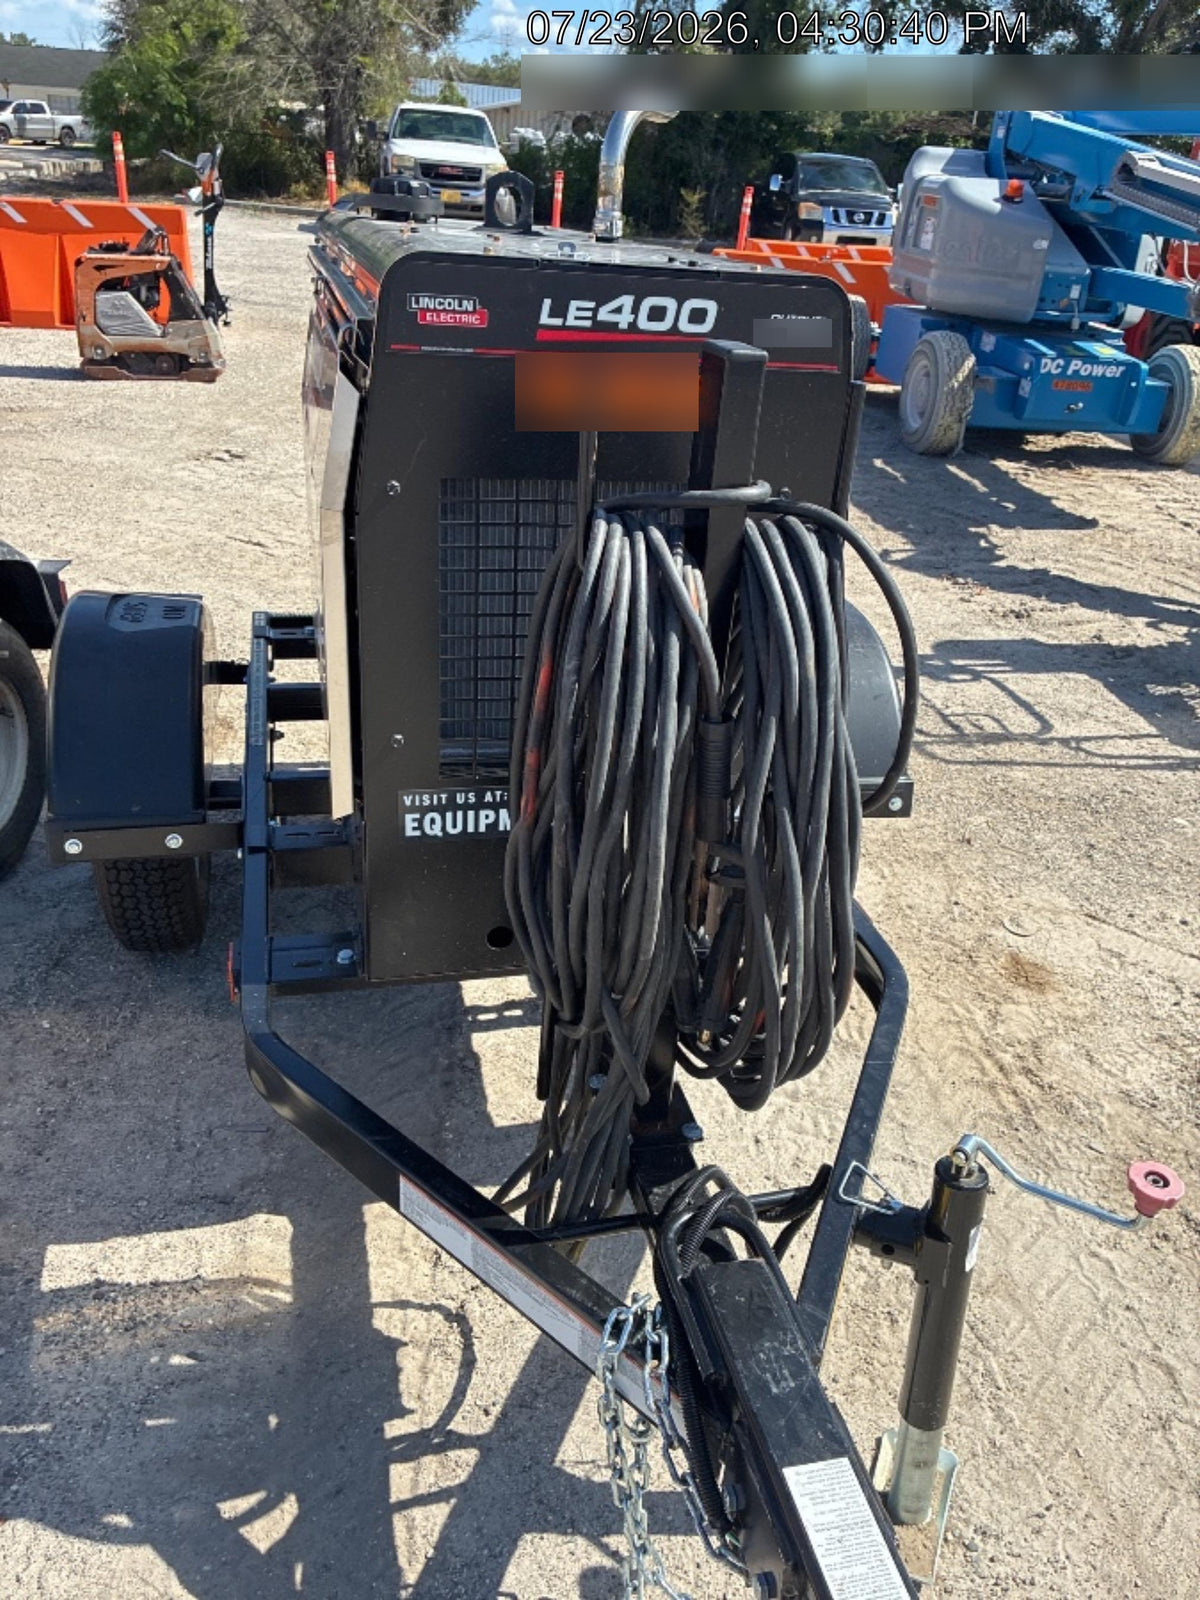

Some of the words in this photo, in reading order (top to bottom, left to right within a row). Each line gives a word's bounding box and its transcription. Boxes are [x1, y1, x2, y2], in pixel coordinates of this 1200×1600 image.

[412, 296, 473, 310] LINCOLN
[426, 313, 480, 324] ELECTRIC
[538, 294, 719, 334] LE400
[1041, 358, 1064, 374] DC
[1067, 359, 1126, 377] Power
[403, 795, 448, 806] VISIT
[456, 792, 477, 804] US
[484, 790, 508, 803] AT:
